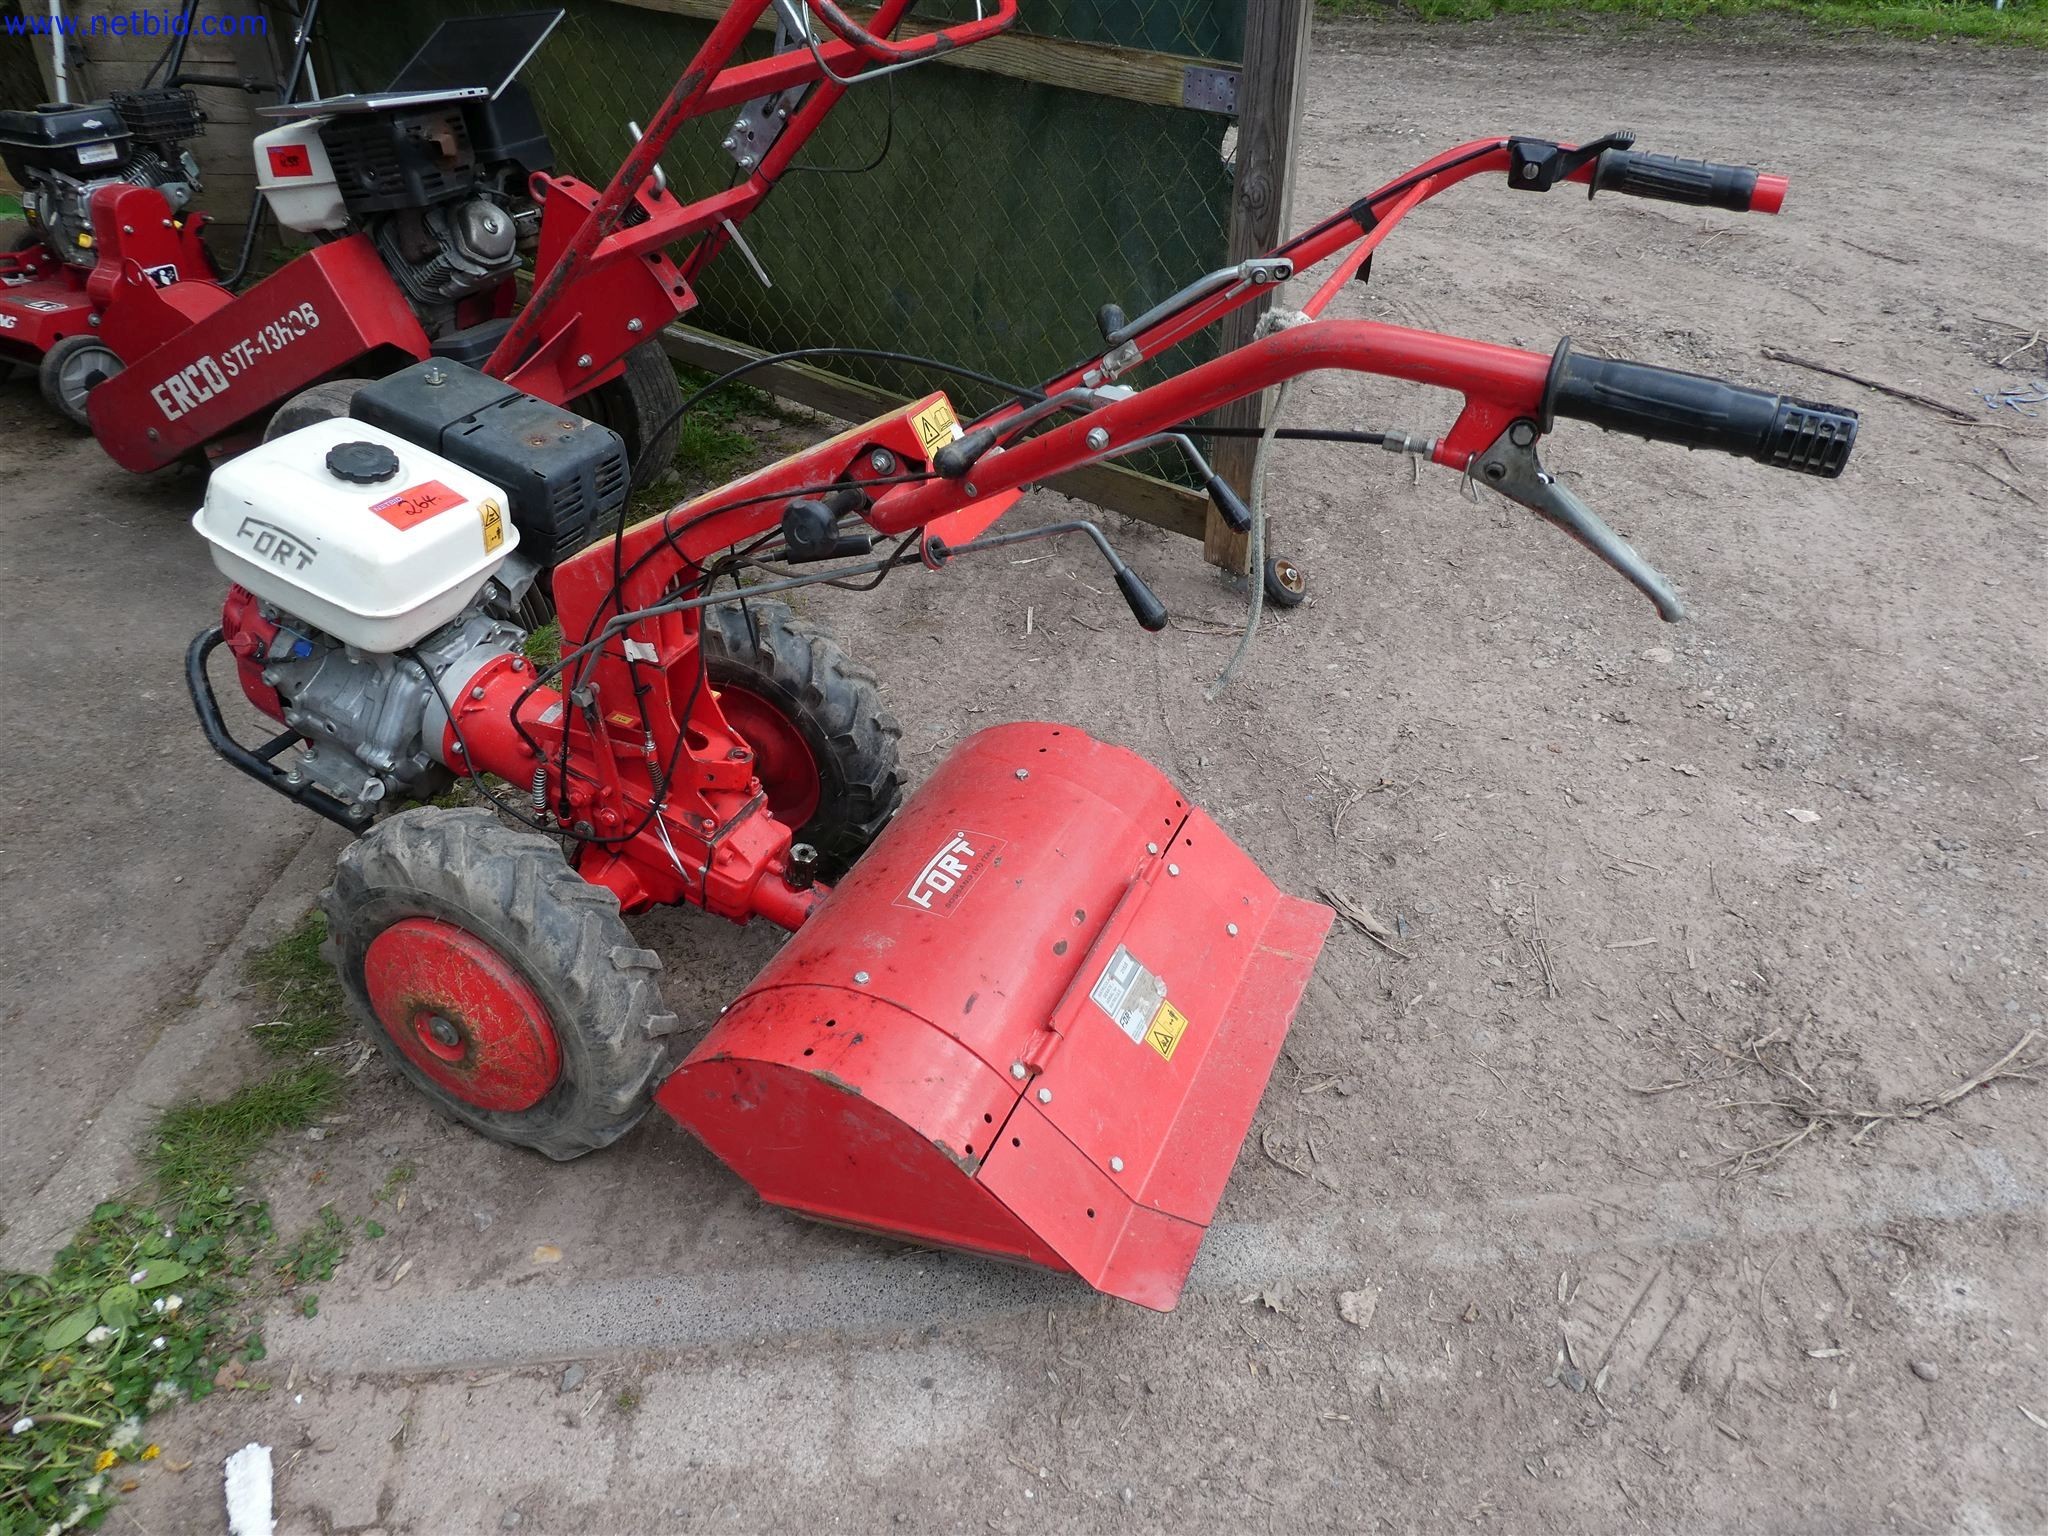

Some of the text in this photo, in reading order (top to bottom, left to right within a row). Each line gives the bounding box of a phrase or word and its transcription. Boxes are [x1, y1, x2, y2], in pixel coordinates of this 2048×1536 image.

[150, 355, 231, 421] ERCO
[236, 516, 318, 570] FORT
[907, 836, 975, 908] FORT
